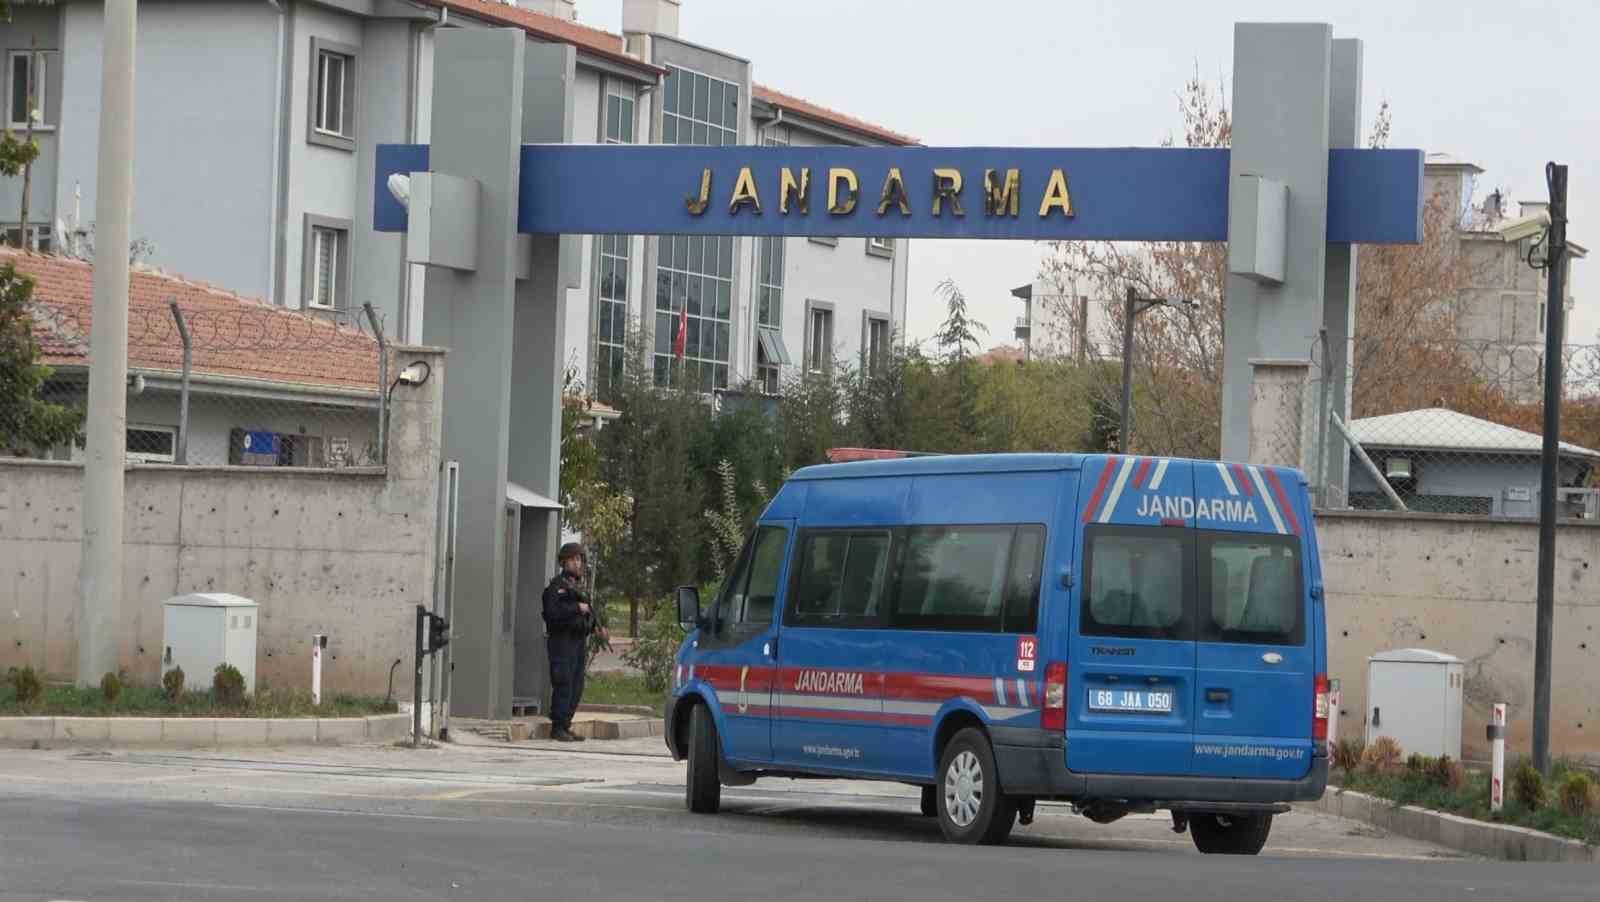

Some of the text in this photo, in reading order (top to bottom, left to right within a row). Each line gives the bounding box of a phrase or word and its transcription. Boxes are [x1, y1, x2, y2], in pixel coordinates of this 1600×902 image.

[686, 167, 1075, 217] JANDARMA
[1136, 494, 1258, 524] JANDARMA
[1020, 640, 1035, 658] 112
[794, 669, 864, 694] JANDARMA
[1097, 690, 1170, 709] 68 JAA 050
[1194, 744, 1305, 760] www.jandarma.gov.tr
